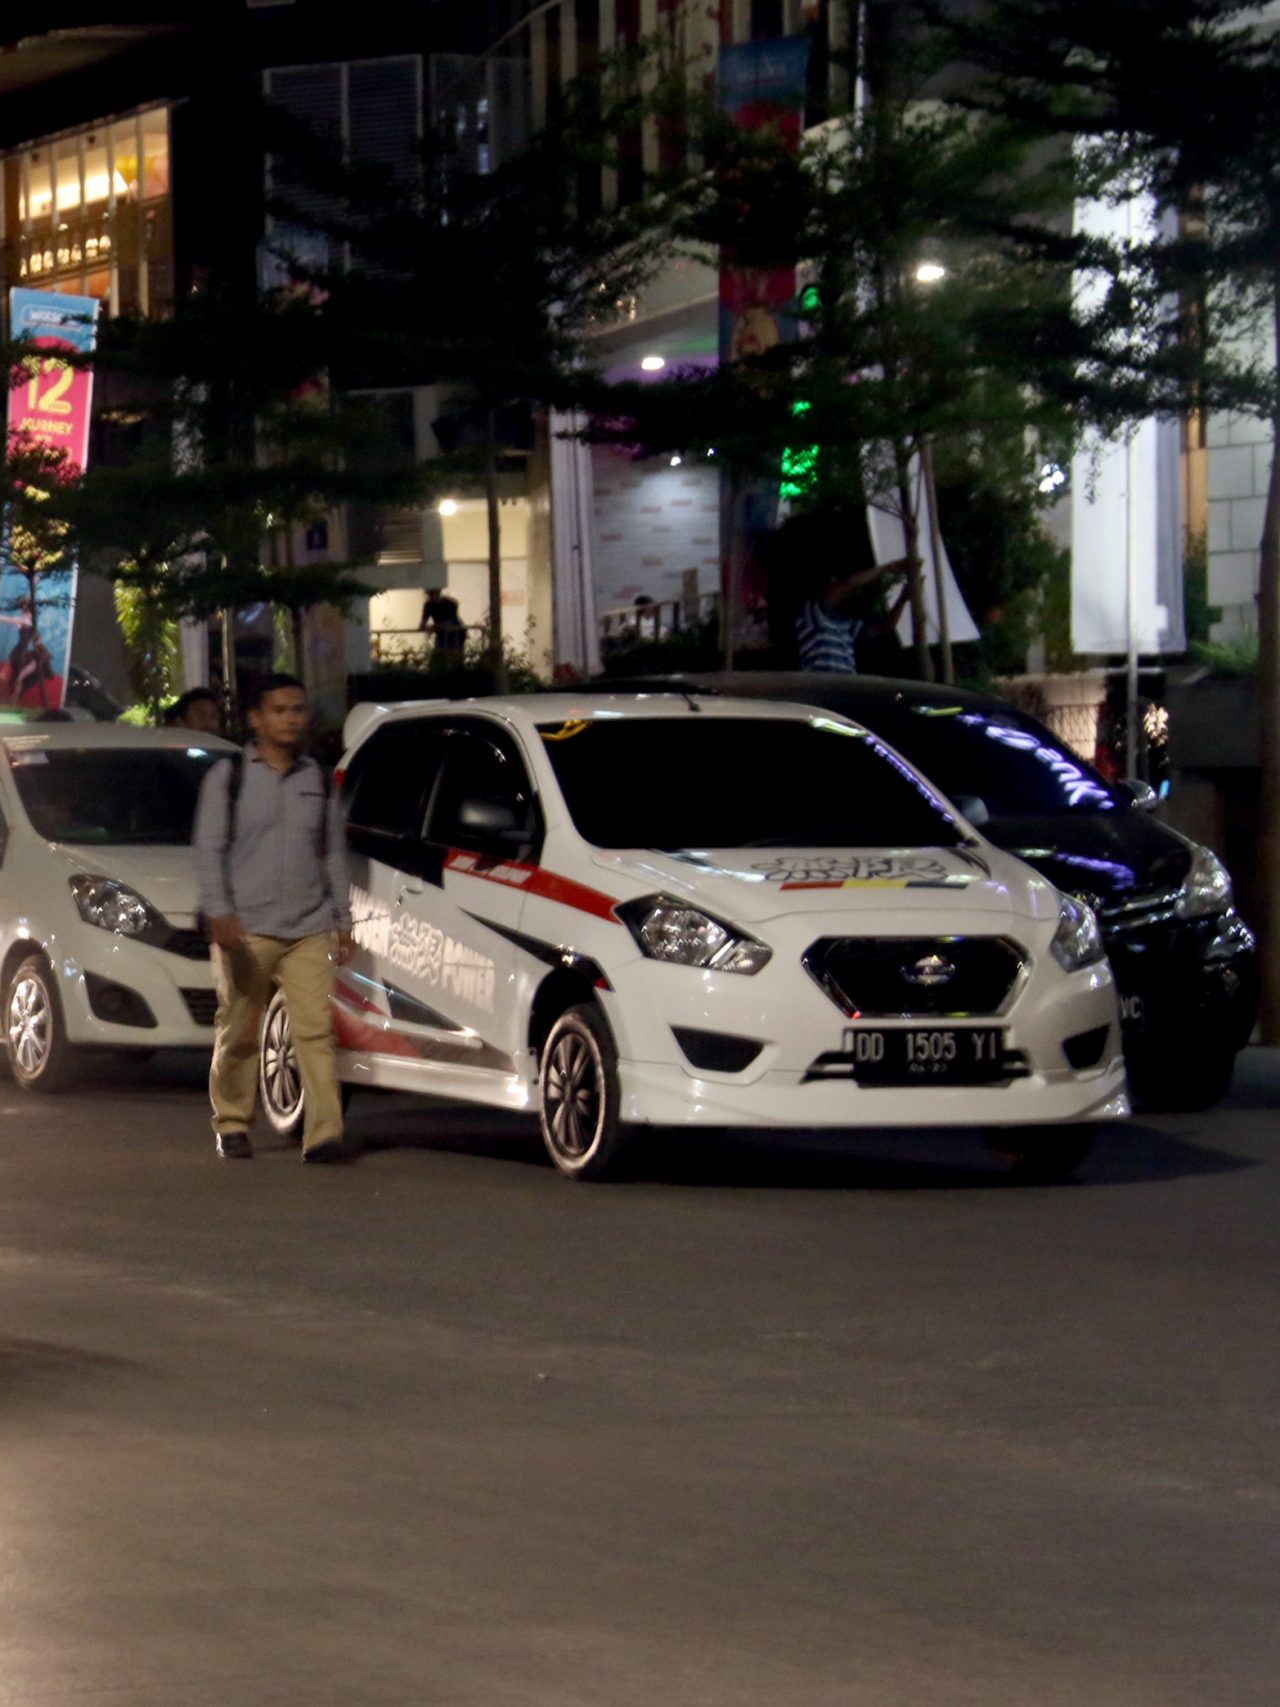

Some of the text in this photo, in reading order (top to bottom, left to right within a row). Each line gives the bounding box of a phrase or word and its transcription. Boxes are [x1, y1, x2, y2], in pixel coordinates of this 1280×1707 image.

[22, 356, 74, 415] 12
[856, 1032, 885, 1062] DD
[906, 1032, 958, 1061] 1505
